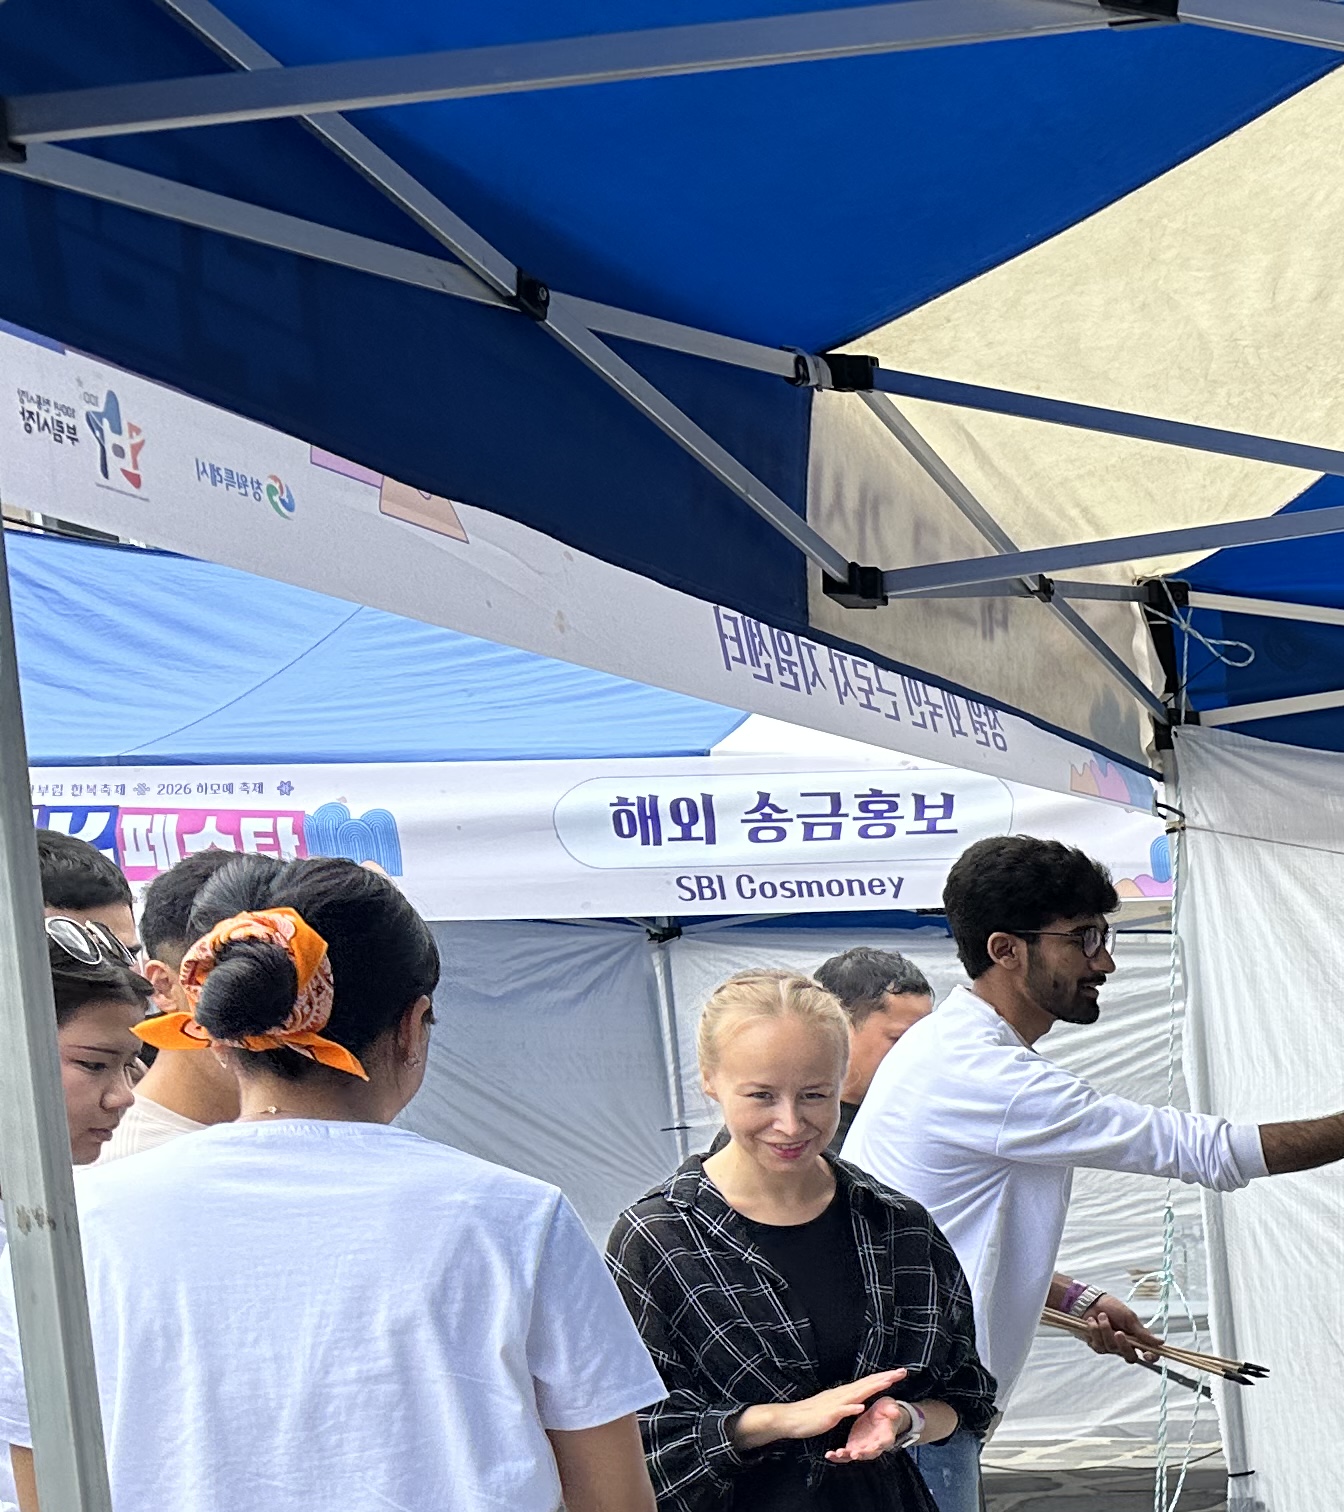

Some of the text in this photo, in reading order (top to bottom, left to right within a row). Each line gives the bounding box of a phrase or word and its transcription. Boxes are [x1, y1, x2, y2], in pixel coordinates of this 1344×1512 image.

[30, 784, 63, 797] 부림
[157, 783, 192, 796] 2026
[239, 782, 264, 796] 축제
[612, 787, 958, 847] 해외 송금홍보
[675, 873, 904, 902] SBI Cosmoney
